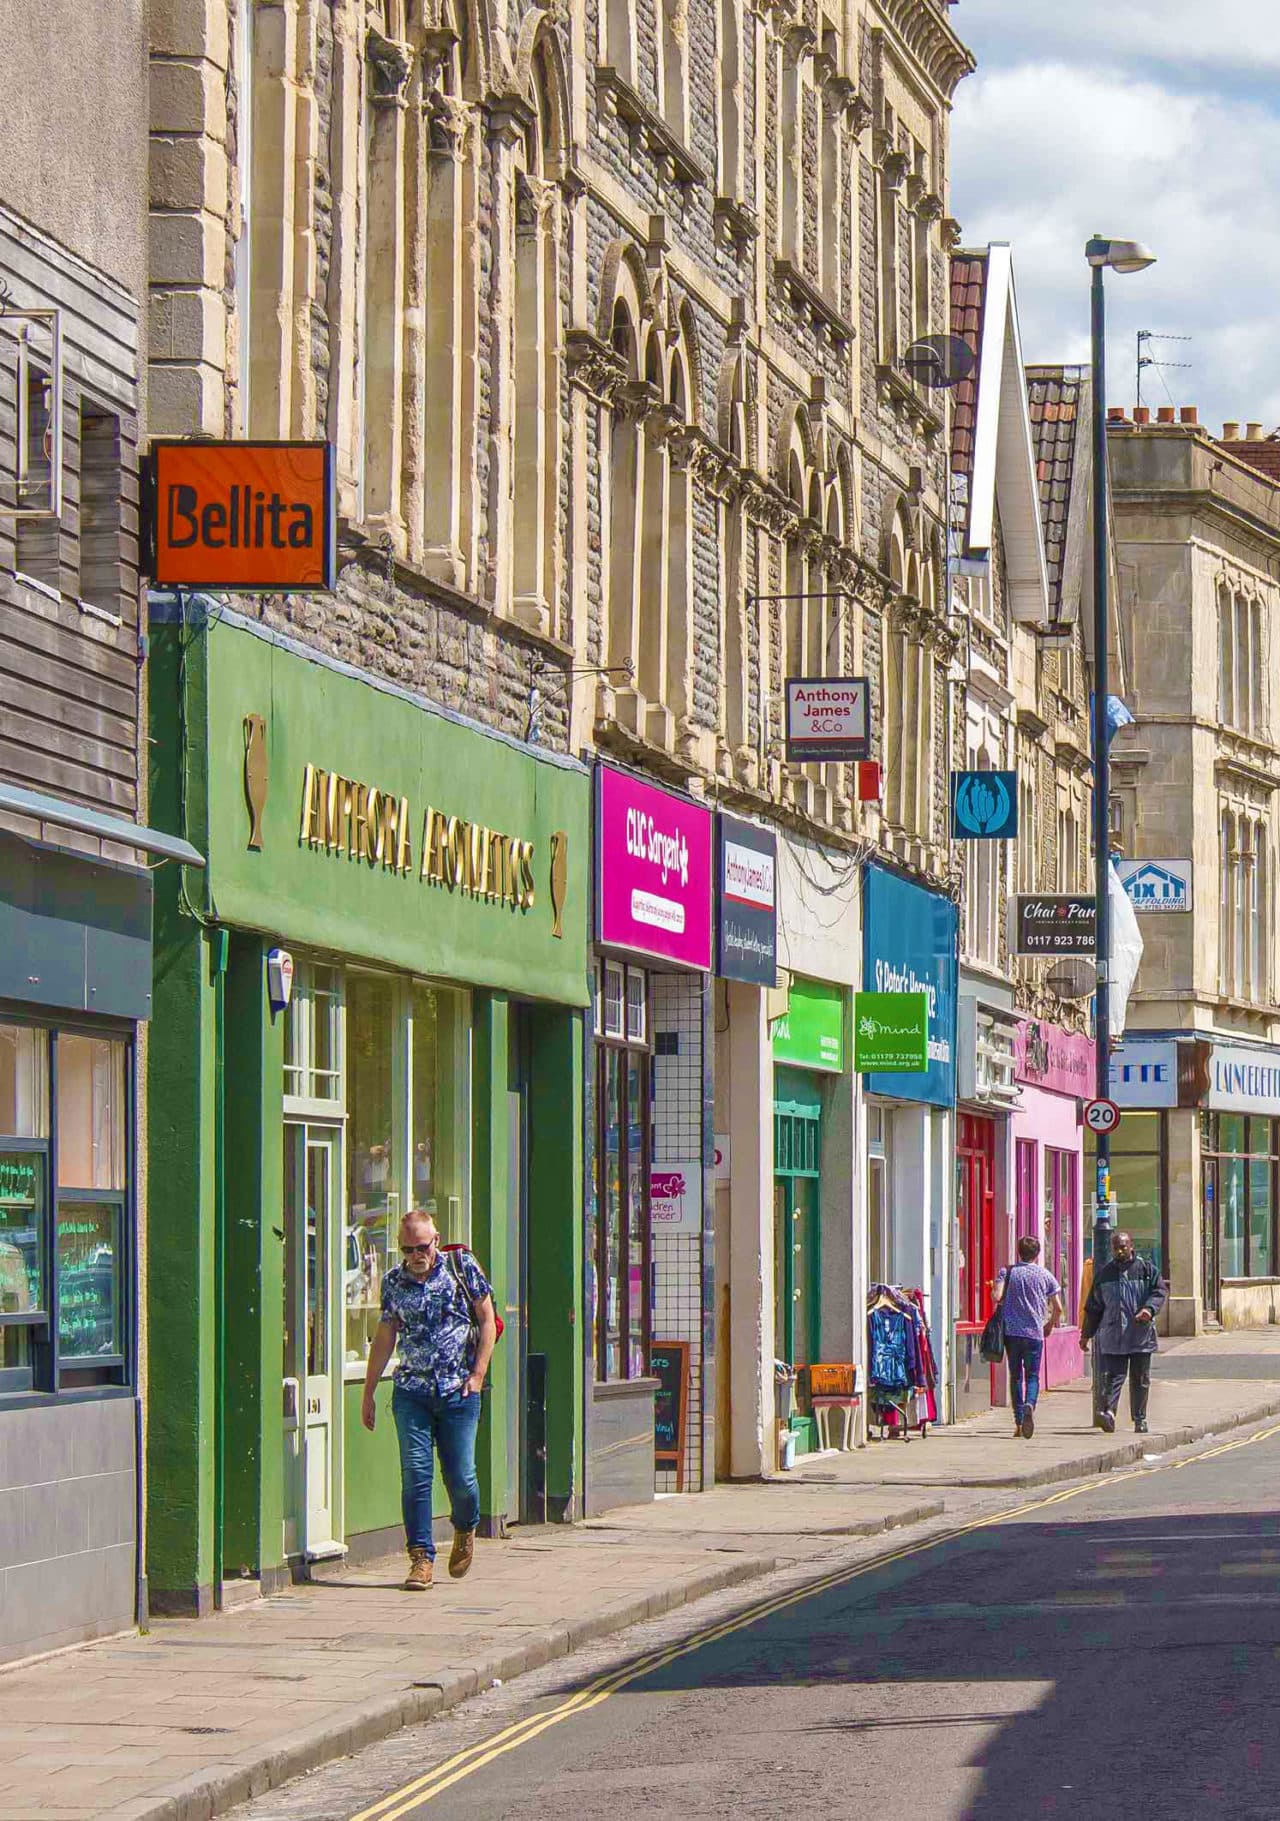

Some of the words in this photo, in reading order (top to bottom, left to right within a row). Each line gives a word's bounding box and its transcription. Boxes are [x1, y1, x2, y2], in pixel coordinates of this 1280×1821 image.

[167, 484, 314, 549] Bellita
[794, 688, 859, 705] Anthony
[803, 704, 852, 717] James
[811, 719, 843, 733] &Co
[626, 807, 647, 860] CLIC
[647, 815, 681, 886] Sargent
[1162, 879, 1185, 898] IT
[1023, 902, 1057, 919] Chai
[1027, 935, 1052, 946] 0117
[1053, 935, 1073, 946] 923
[879, 1021, 922, 1035] mind
[1090, 1108, 1114, 1123] 20
